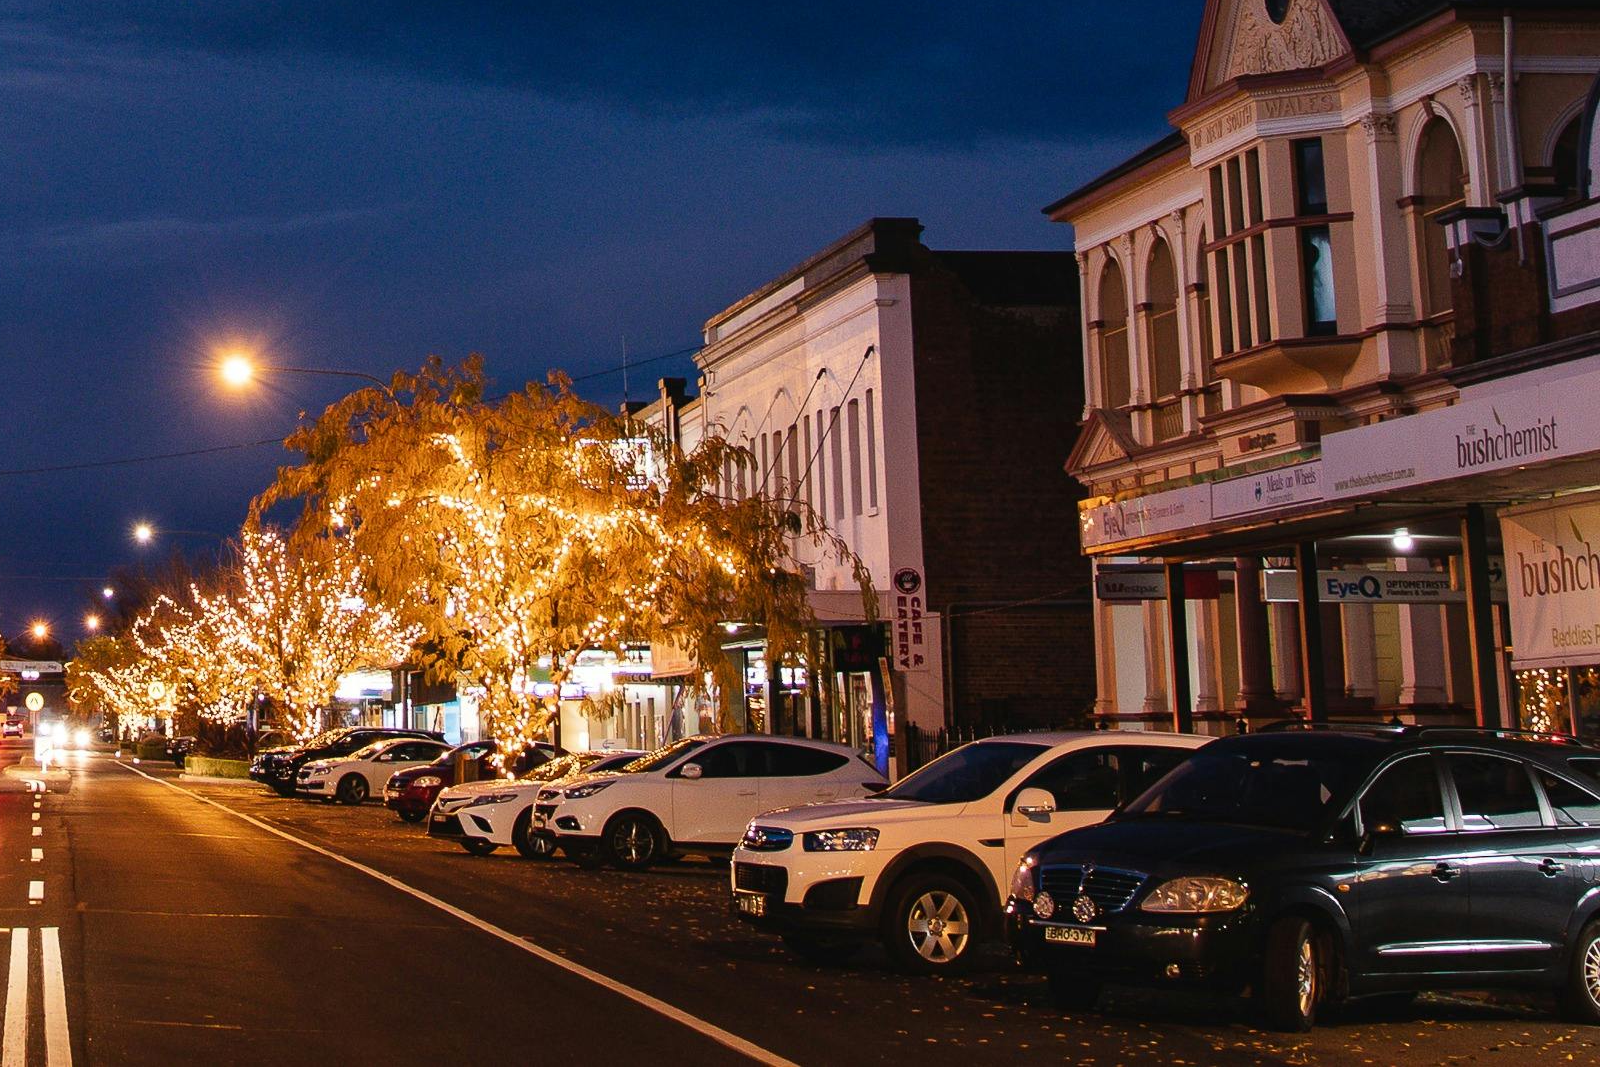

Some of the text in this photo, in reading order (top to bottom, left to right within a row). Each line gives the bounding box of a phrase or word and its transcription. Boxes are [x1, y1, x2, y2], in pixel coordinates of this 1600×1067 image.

[1266, 93, 1334, 118] WALES
[1205, 117, 1223, 146] NEW
[1226, 104, 1251, 135] SOUTH
[1456, 416, 1558, 468] bushchemist
[1266, 474, 1284, 493] Meals
[1294, 467, 1317, 486] Wheels
[1334, 466, 1416, 492] www.thebushchemist.com.au
[1532, 538, 1547, 554] THE
[1326, 575, 1450, 598] EyeQ OPTOMETRISTS
[896, 595, 910, 669] EATERY
[910, 596, 924, 667] CAFE &
